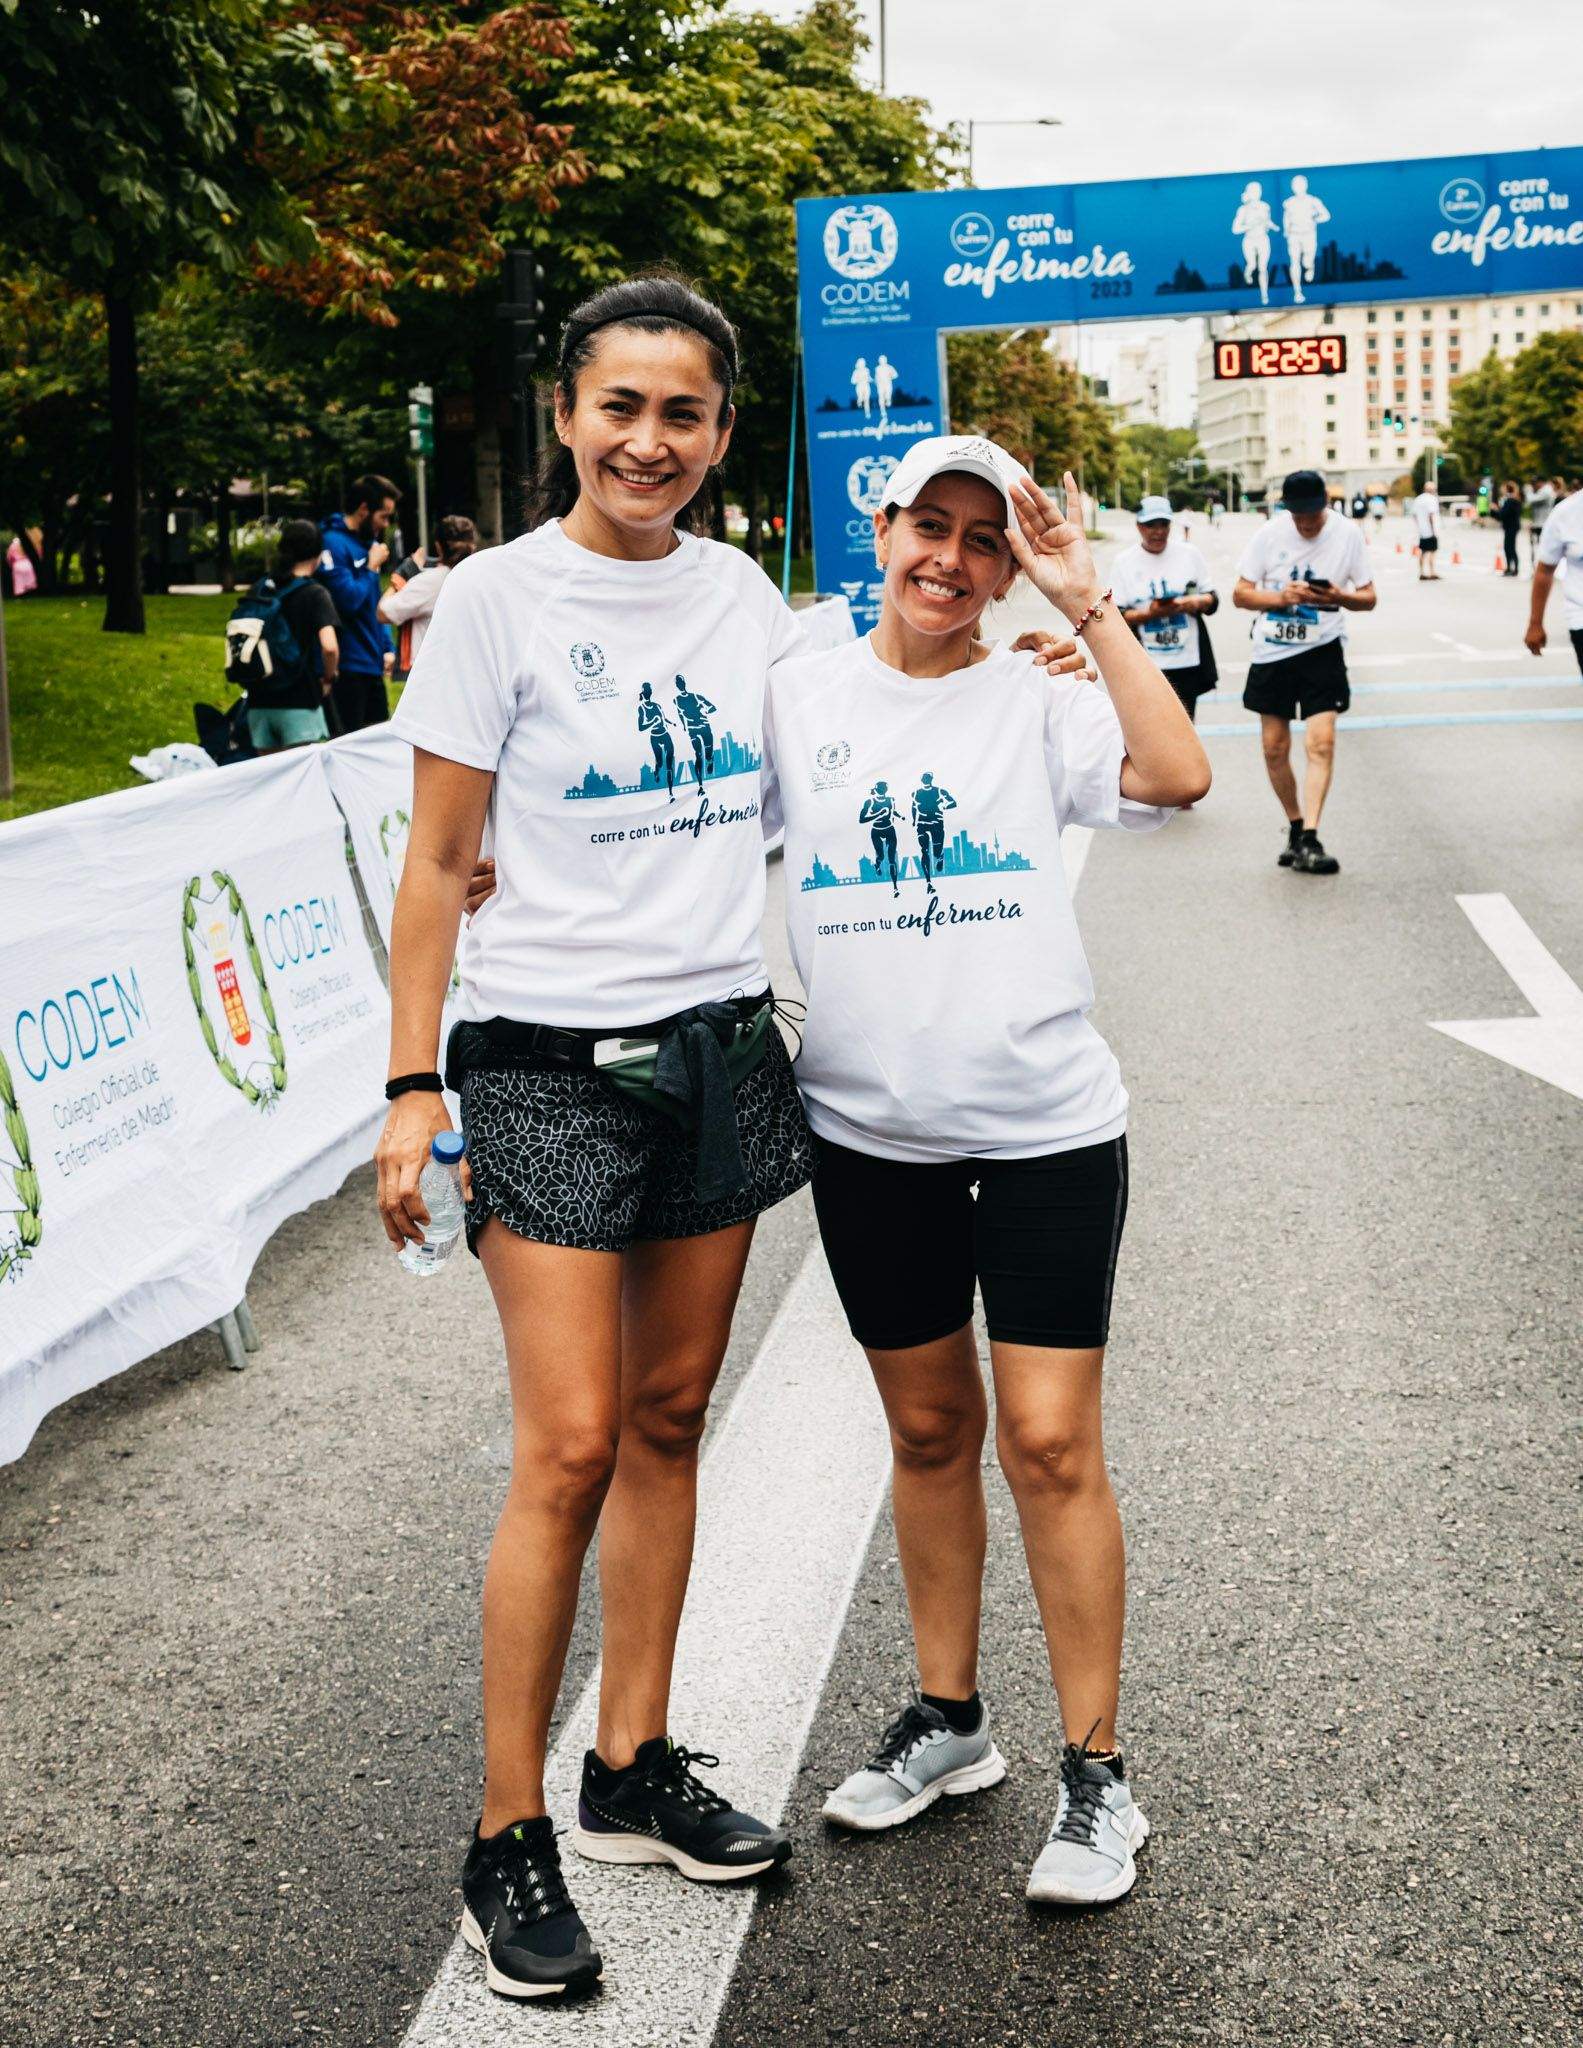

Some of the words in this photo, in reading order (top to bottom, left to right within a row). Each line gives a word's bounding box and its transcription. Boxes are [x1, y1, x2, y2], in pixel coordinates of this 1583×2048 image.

[1499, 178, 1549, 197] corre
[1509, 196, 1544, 213] con
[1548, 192, 1569, 210] tu
[1007, 213, 1054, 230] corre
[1017, 231, 1050, 247] con
[1054, 227, 1073, 244] tu
[1431, 204, 1583, 266] enferme
[943, 237, 1135, 299] enfermera
[821, 280, 909, 305] CODEM
[1090, 280, 1132, 299] 2023
[1275, 623, 1307, 640] 368
[575, 676, 616, 691] CODEM
[590, 831, 625, 844] corre
[629, 826, 650, 840] con
[653, 822, 665, 836] tu
[818, 923, 849, 936] corre
[853, 920, 876, 932] con
[880, 917, 892, 930] tu
[896, 895, 1024, 936] enfermera
[265, 895, 347, 970] CODEM
[15, 967, 151, 1082] CODEM
[53, 1088, 101, 1129] Colegio
[100, 1063, 143, 1104] Oficial
[141, 1057, 160, 1085] de
[121, 1115, 140, 1140] de
